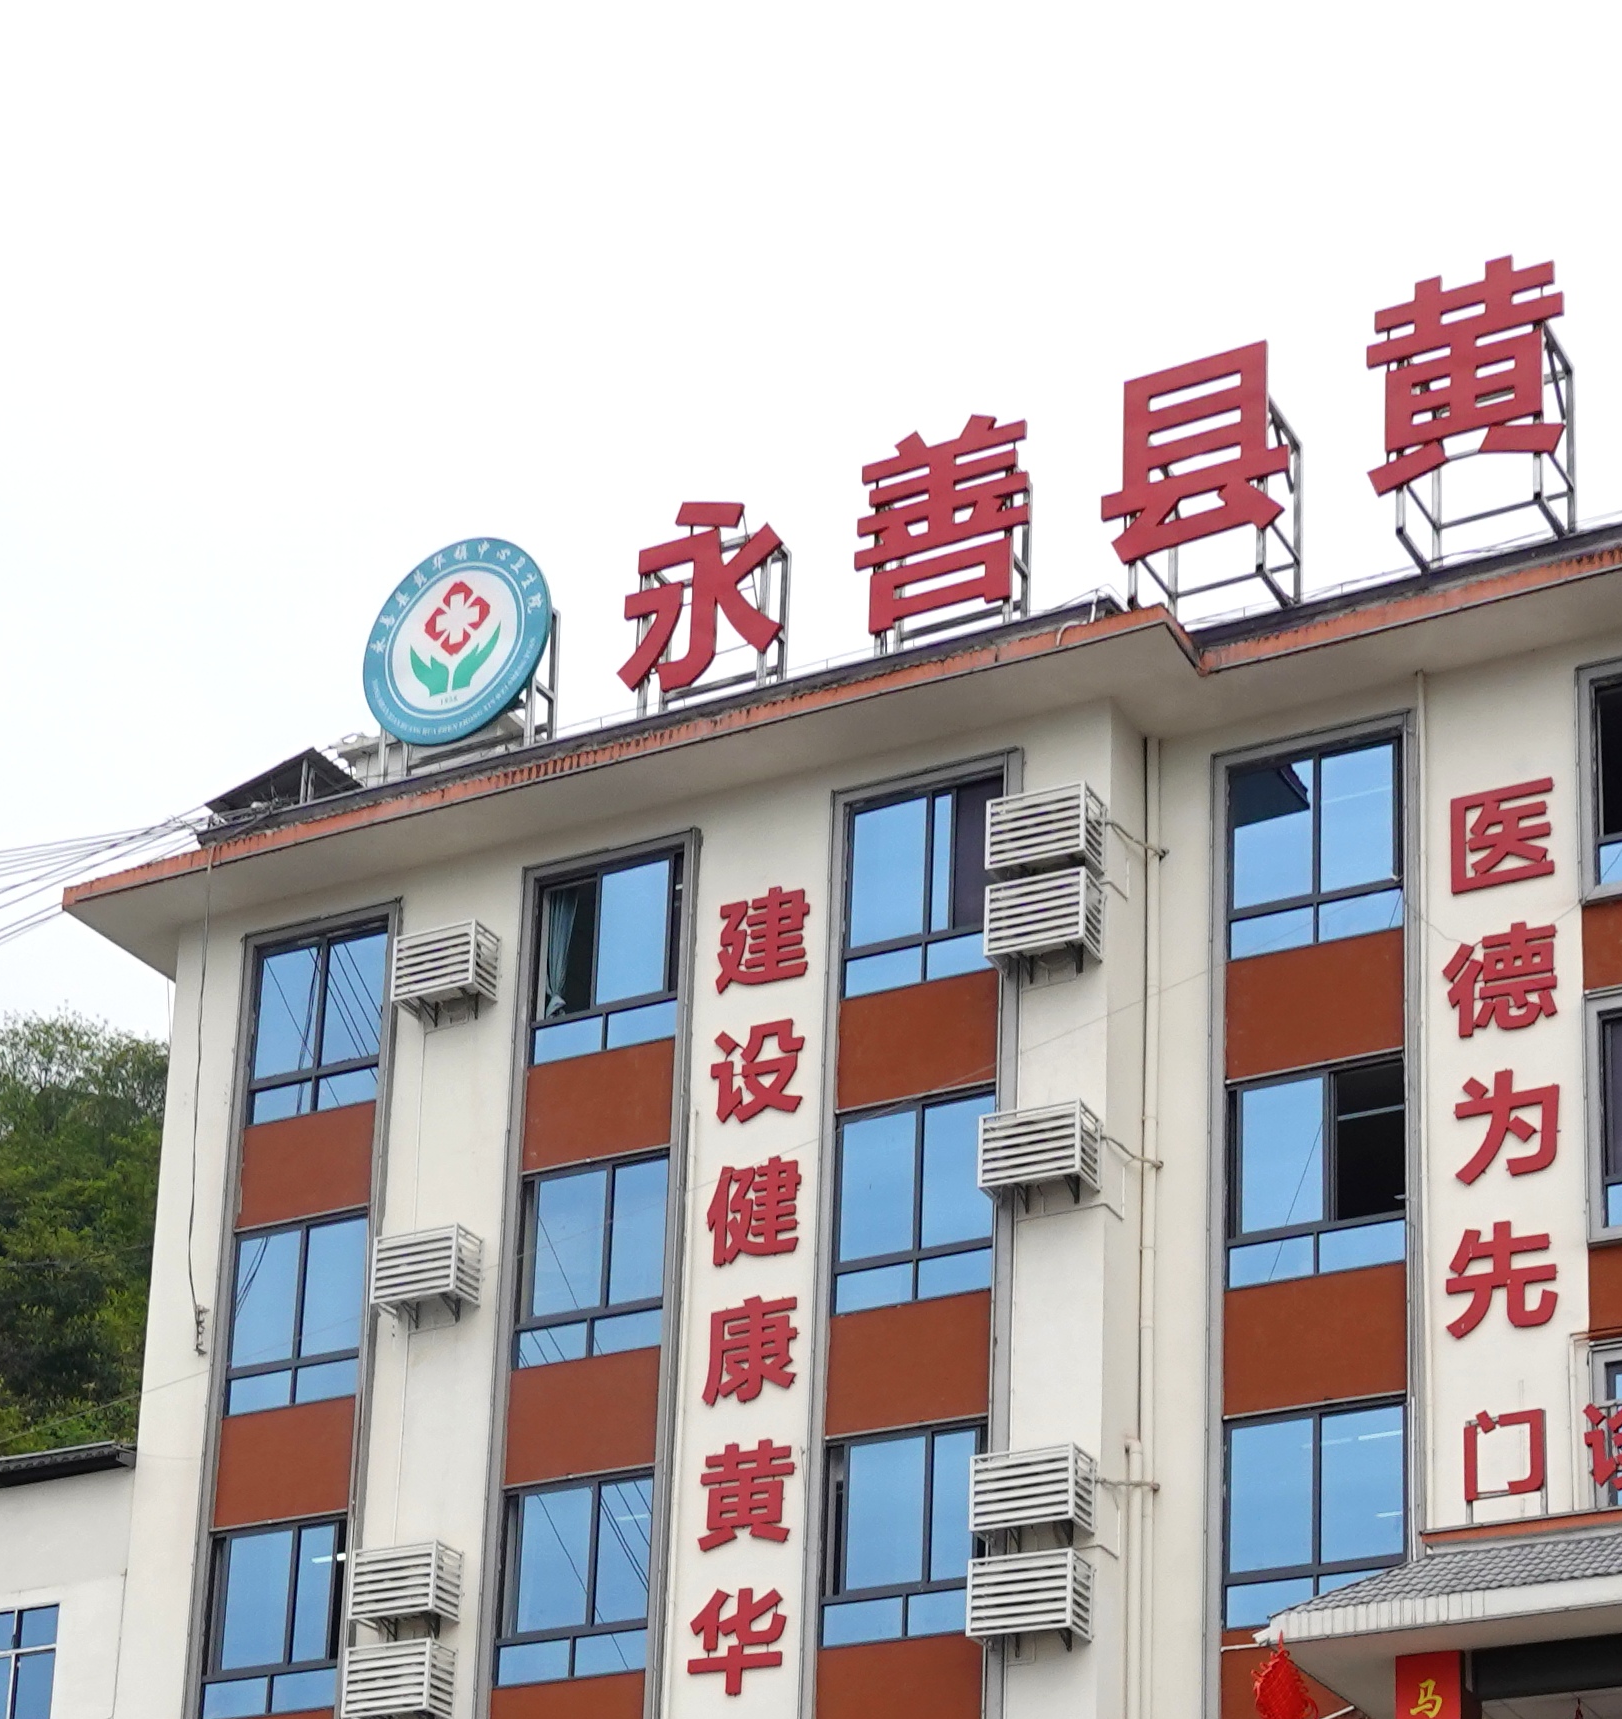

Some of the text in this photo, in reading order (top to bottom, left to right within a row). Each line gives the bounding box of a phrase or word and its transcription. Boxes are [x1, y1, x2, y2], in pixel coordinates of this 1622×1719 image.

[687, 886, 810, 1697] 建设健康黄华
[1442, 777, 1560, 1339] 医德为先
